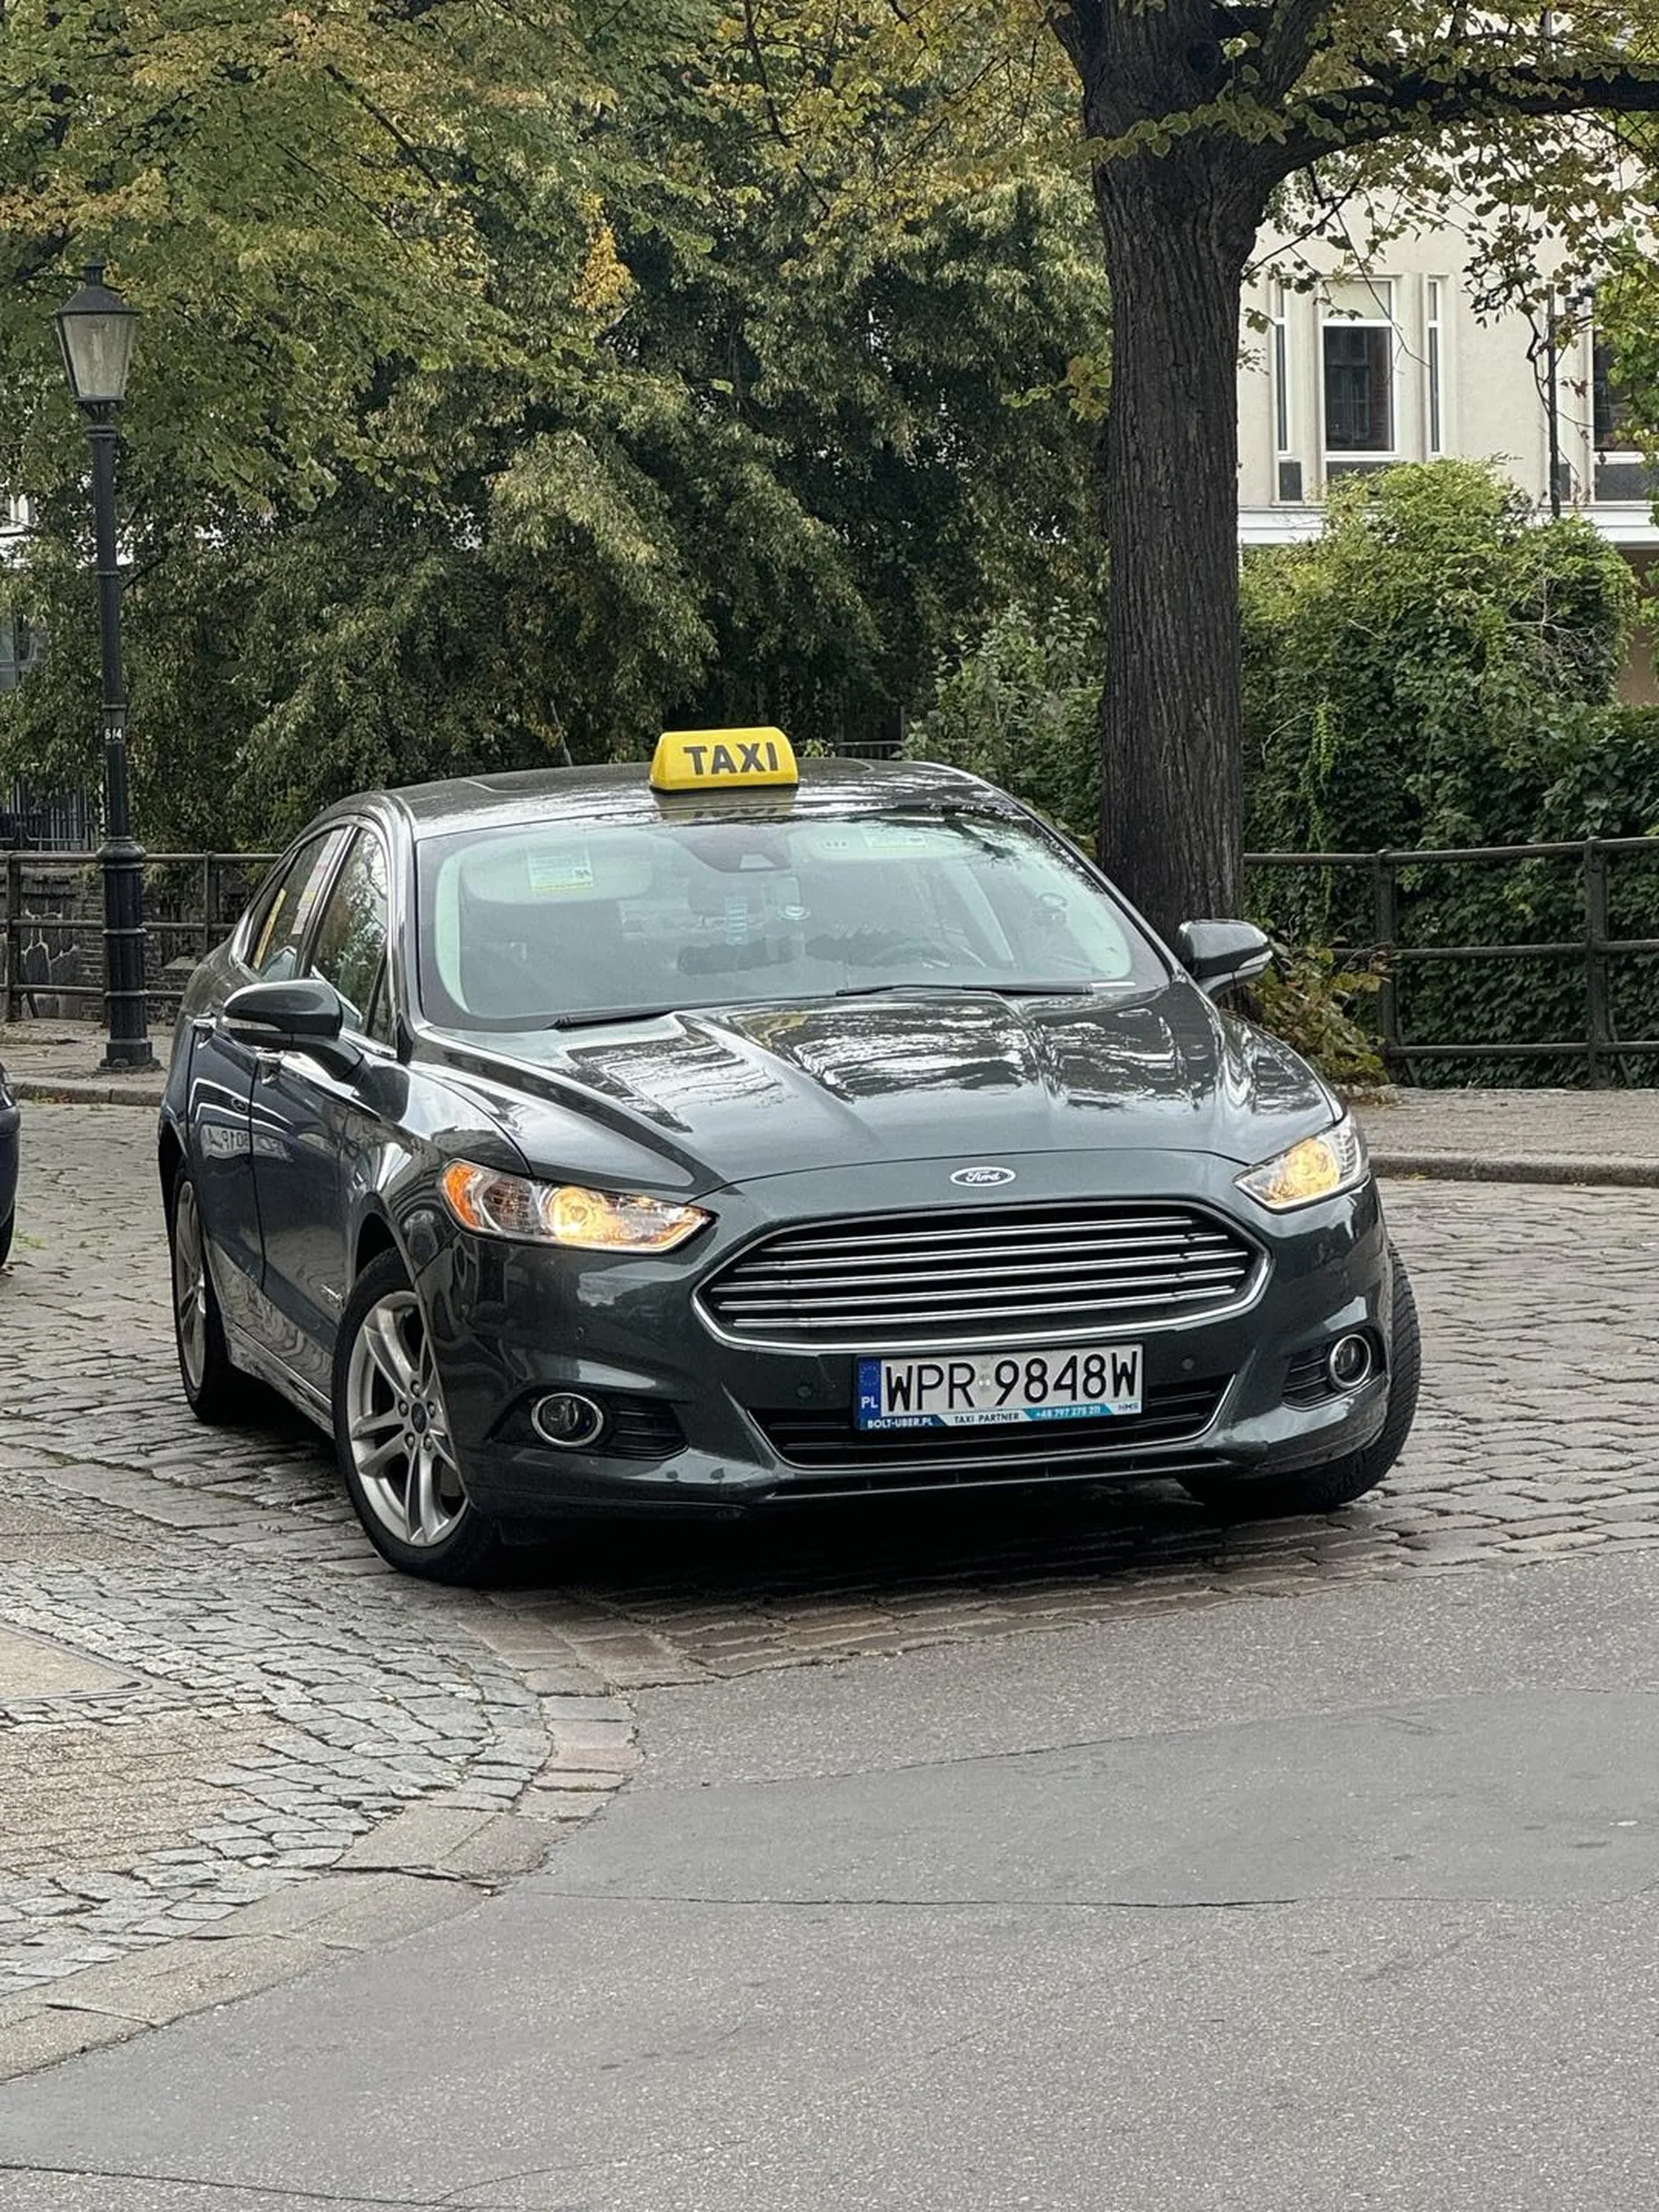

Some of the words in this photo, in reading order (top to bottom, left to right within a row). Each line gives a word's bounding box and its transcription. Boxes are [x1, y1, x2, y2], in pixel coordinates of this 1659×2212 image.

[683, 741, 779, 775] TAXI
[965, 1170, 1000, 1182] Ford
[886, 1363, 975, 1412] WPR
[995, 1351, 1138, 1406] 9848W
[861, 1396, 879, 1409] PL
[867, 1417, 933, 1429] BOLT-UBER.PL
[954, 1414, 974, 1425] TAXI
[978, 1412, 1019, 1423] PARTNER
